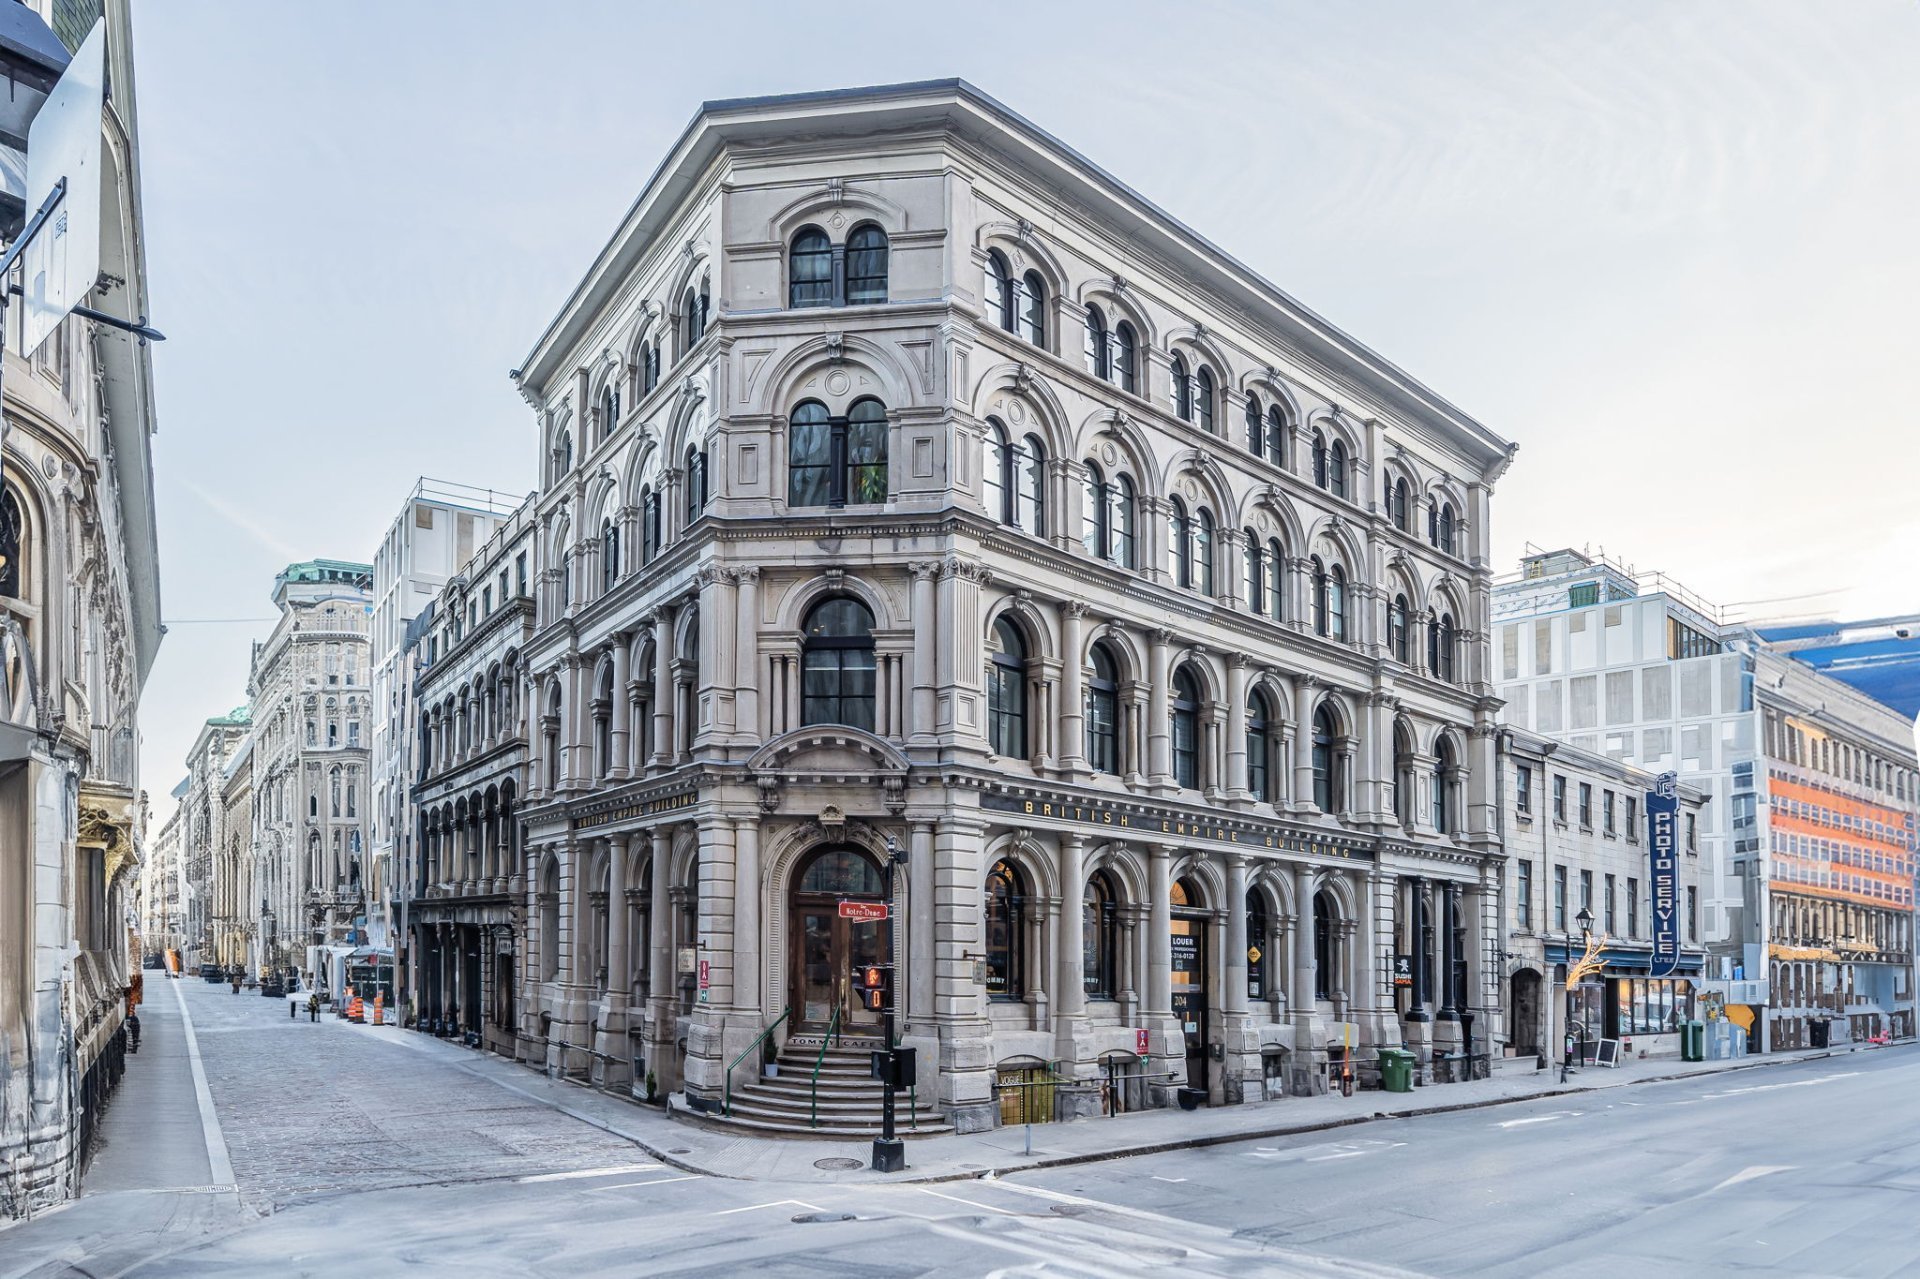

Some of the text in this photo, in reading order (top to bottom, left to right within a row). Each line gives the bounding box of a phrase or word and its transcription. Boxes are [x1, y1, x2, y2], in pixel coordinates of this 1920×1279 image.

[578, 793, 696, 827] BRITISH EMPIRE BUILDING
[1026, 802, 1349, 858] BRITISH EMPIRE BUILDING
[1655, 813, 1672, 954] PHOTO SERVICE
[1174, 996, 1187, 1007] 204
